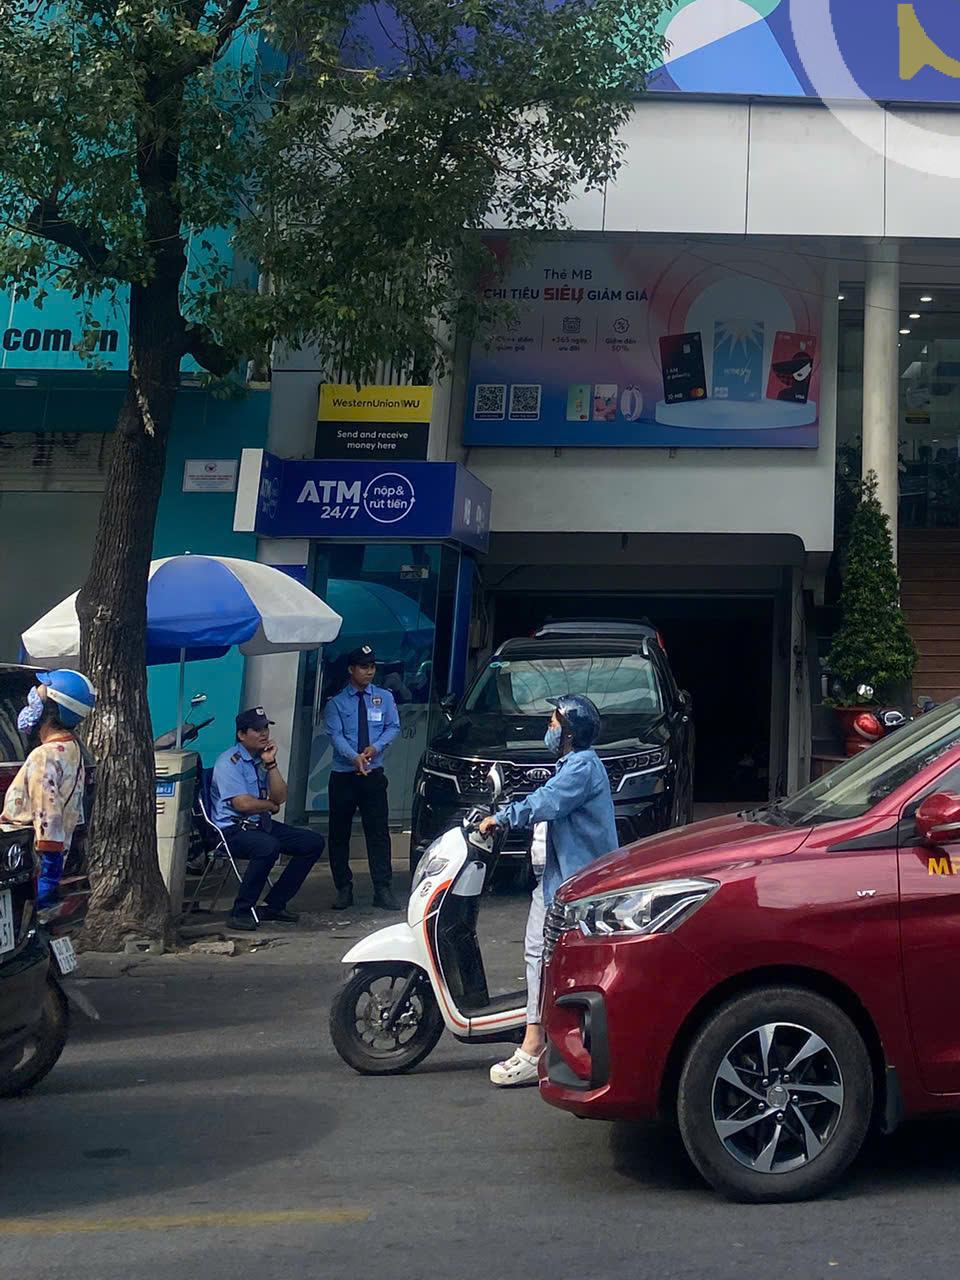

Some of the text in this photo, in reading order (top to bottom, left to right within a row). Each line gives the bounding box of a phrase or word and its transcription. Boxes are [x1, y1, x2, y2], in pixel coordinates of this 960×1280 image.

[571, 269, 593, 280] MB
[510, 286, 540, 300] TIÊU
[587, 286, 623, 301] GIẢM
[625, 287, 649, 301] GIÁ
[332, 399, 400, 408] WesternUnion
[337, 430, 409, 439] Send and receive
[347, 442, 377, 451] money
[296, 480, 362, 503] ATM
[320, 506, 360, 519] 24/7
[530, 771, 547, 779] KIA
